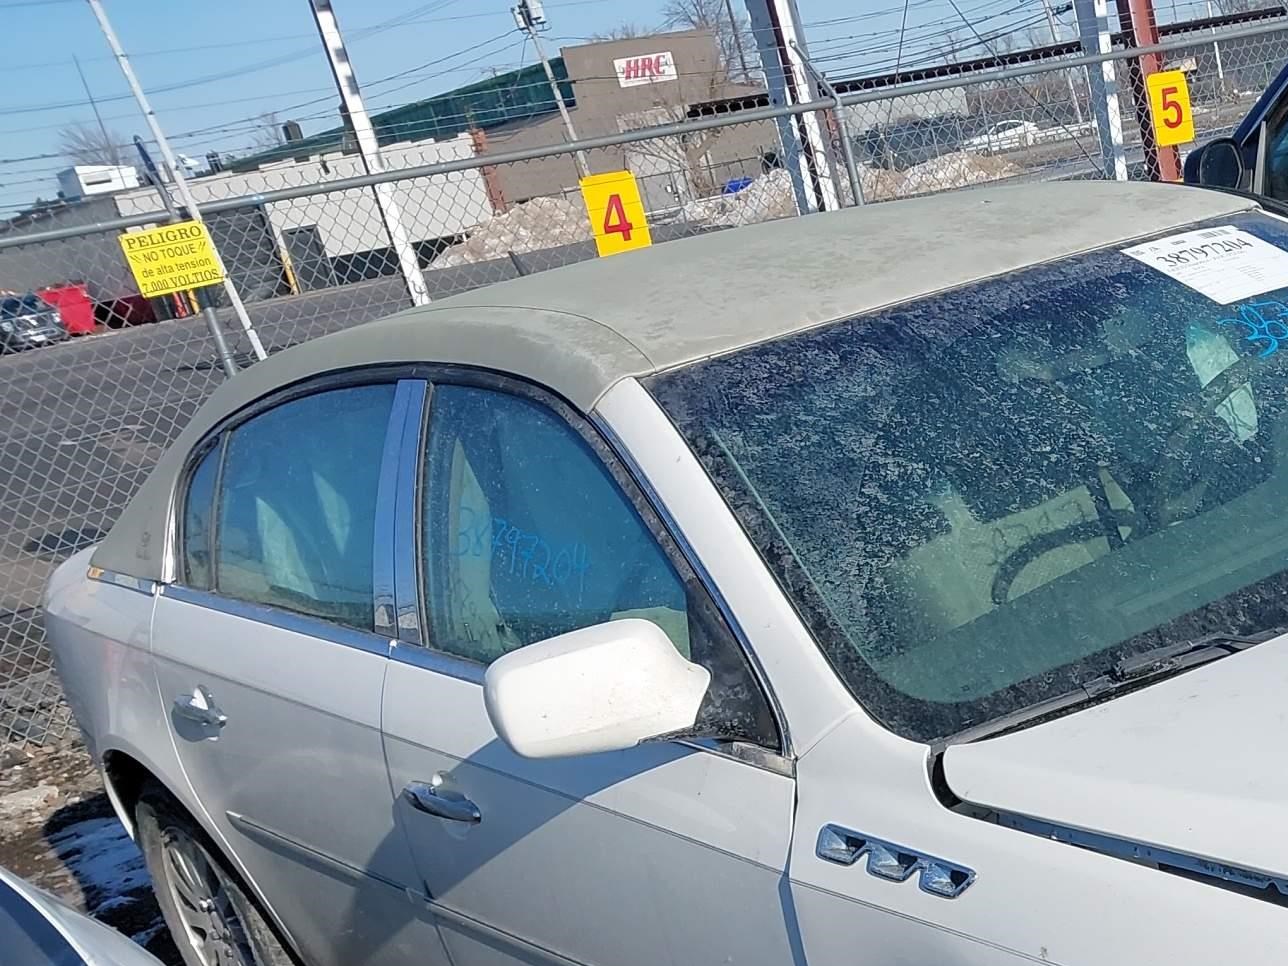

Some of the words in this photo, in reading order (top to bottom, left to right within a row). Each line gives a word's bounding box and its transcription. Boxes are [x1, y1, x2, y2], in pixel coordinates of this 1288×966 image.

[625, 55, 666, 80] HRC
[1162, 87, 1183, 128] 5
[604, 194, 633, 241] 4
[126, 226, 202, 249] PELIGRO
[1156, 238, 1254, 267] 38797204
[142, 268, 155, 279] de
[157, 265, 175, 276] alta
[169, 269, 219, 288] VOLTIOS
